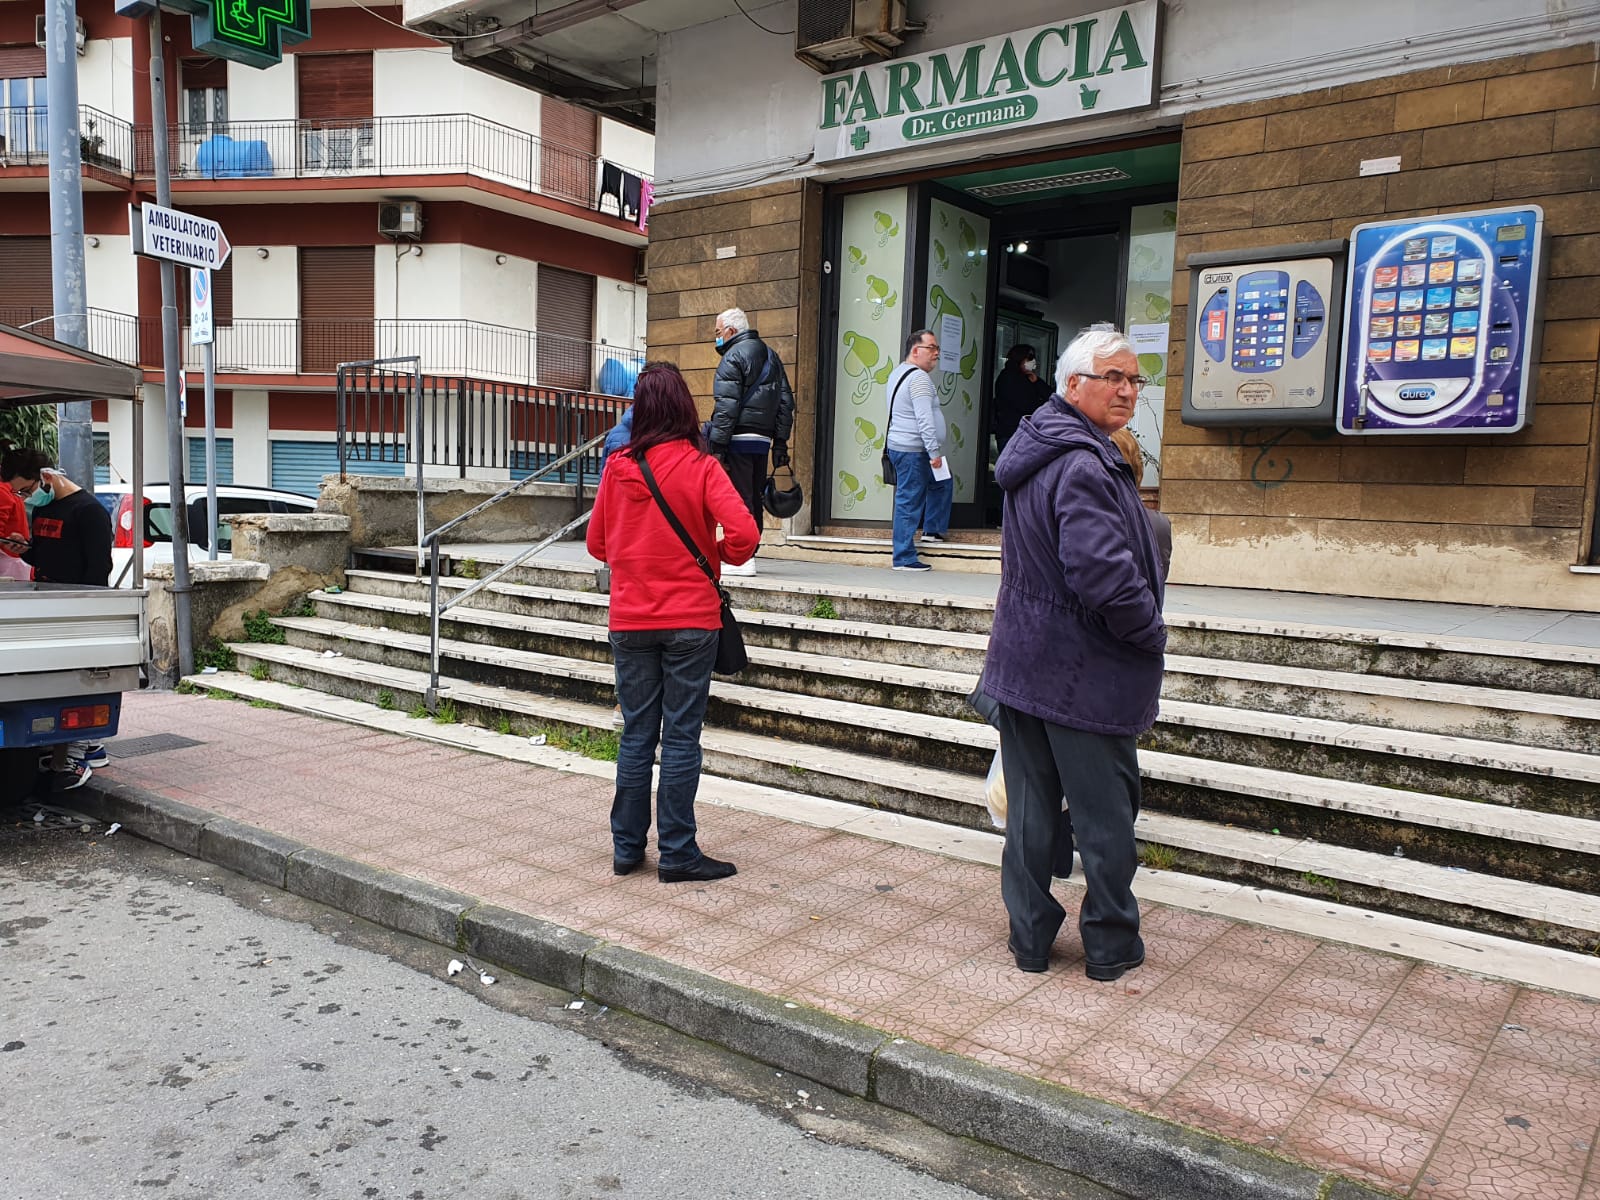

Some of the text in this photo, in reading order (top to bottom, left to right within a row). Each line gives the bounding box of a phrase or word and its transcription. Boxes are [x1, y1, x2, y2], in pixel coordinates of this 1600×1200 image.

[820, 10, 1148, 129] FARMACIA
[911, 100, 1025, 137] Dr. Germanà
[148, 209, 217, 241] AMBULATORIO
[152, 233, 215, 263] VETERINARIO
[1400, 389, 1435, 400] durex
